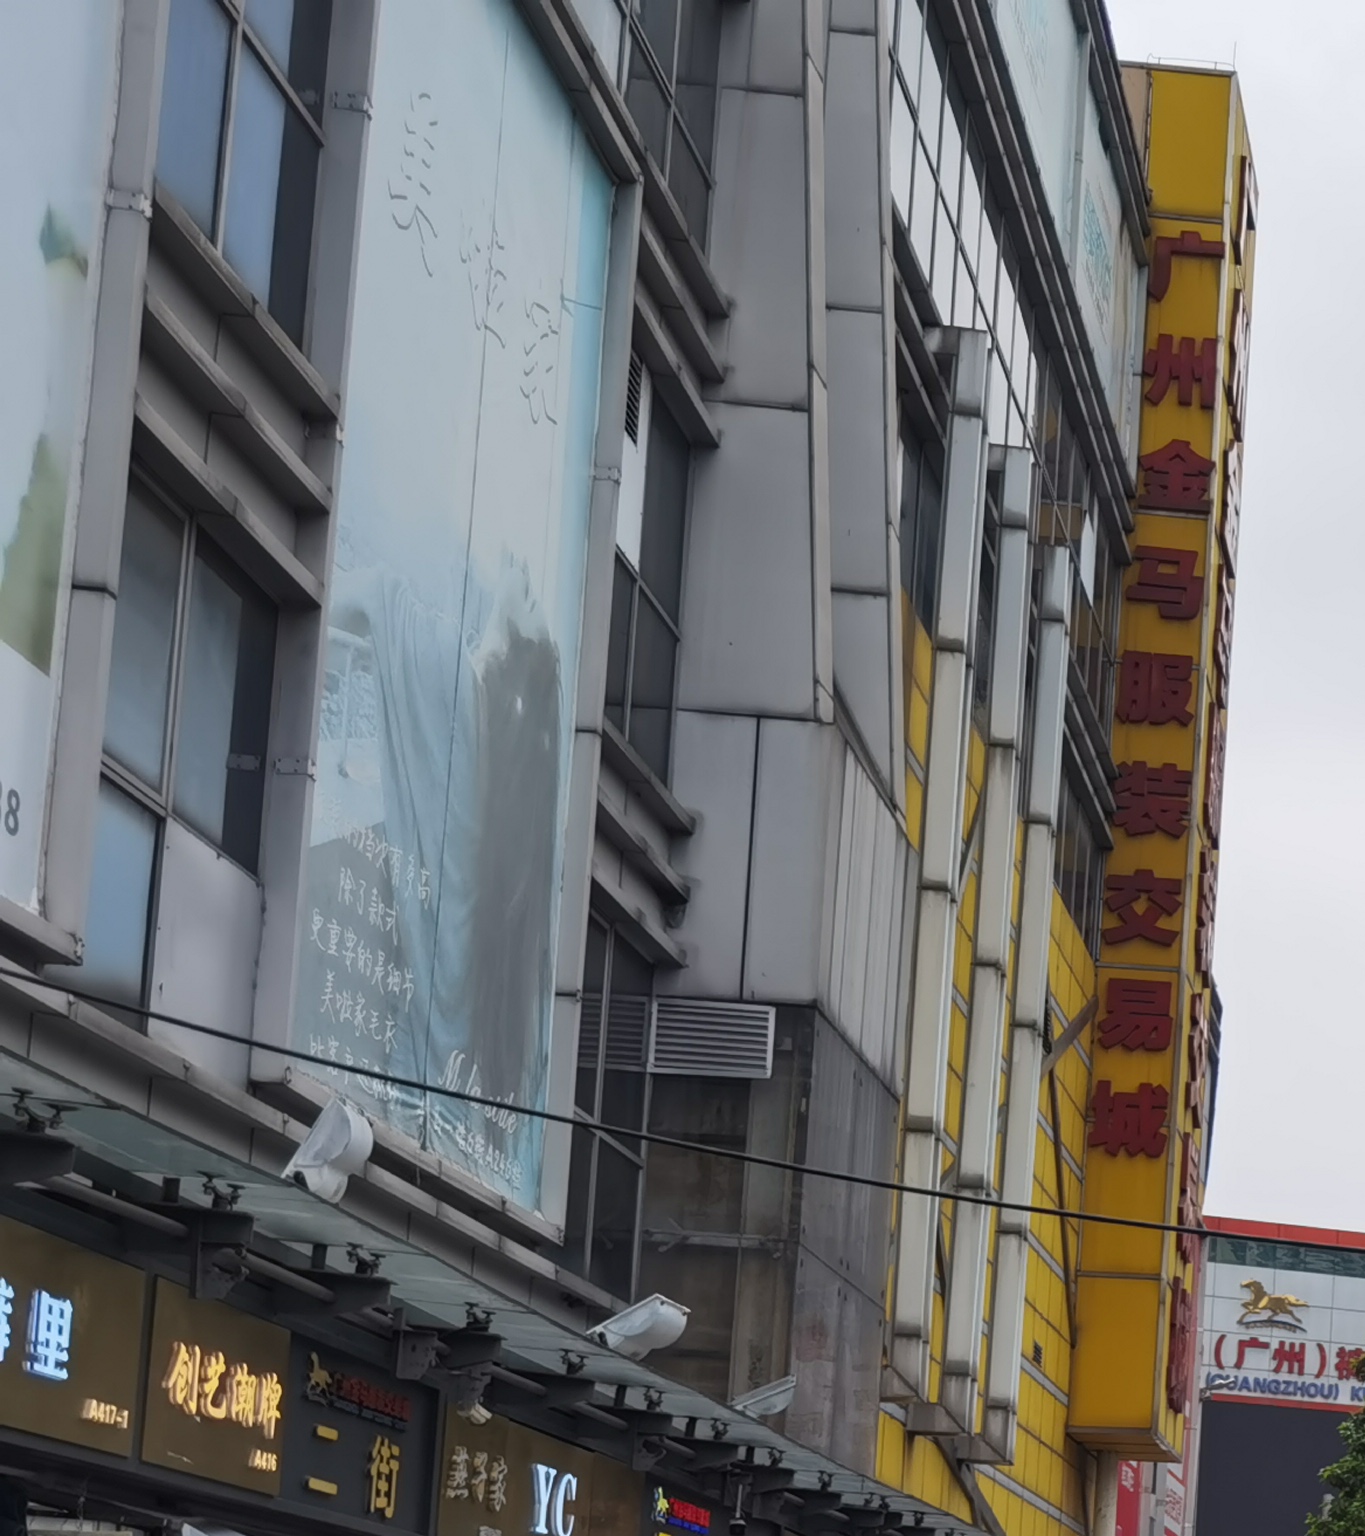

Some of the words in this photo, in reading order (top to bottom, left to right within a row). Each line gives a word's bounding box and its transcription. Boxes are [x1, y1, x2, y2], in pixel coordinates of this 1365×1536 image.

[1088, 230, 1226, 1160] 广州金马服装交易城
[162, 1341, 283, 1439] 创艺潮牌
